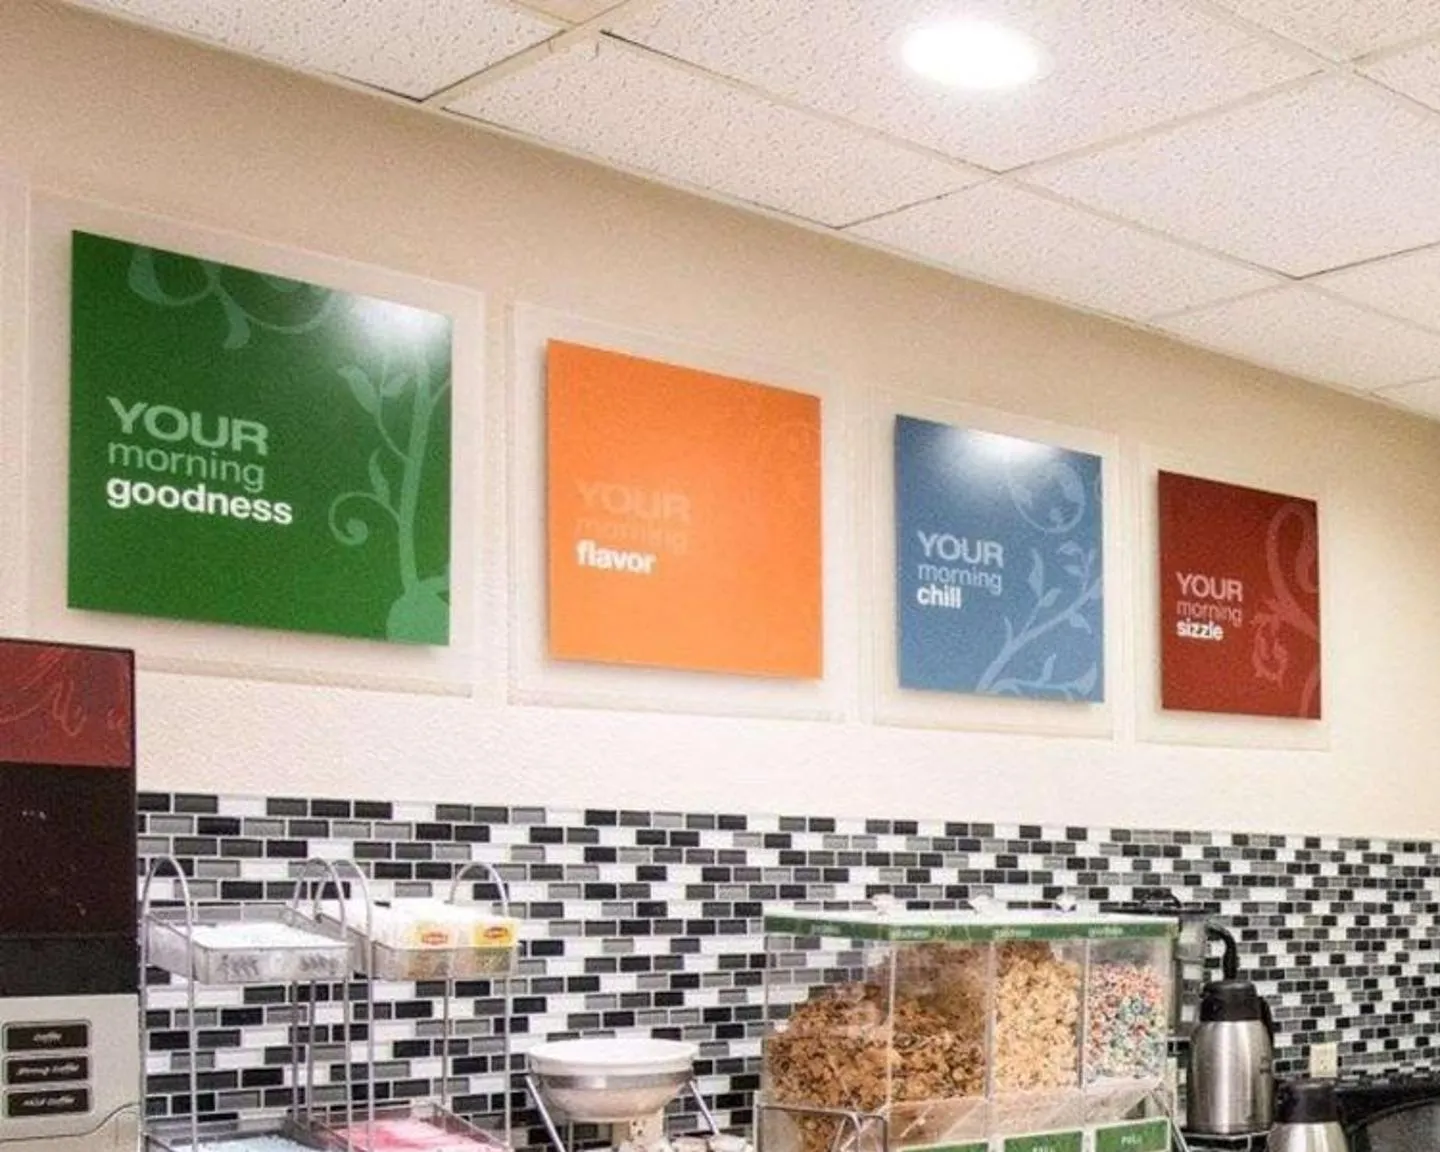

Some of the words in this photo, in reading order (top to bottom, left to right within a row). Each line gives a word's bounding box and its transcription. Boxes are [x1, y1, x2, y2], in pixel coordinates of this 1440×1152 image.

[106, 396, 269, 456] YOUR
[108, 441, 265, 493] morning
[106, 477, 293, 524] goodness
[576, 480, 692, 523] YOUR
[576, 539, 657, 574] flavor
[917, 530, 1004, 568] YOUR
[917, 583, 961, 609] chill
[918, 563, 1002, 596] morning
[1176, 571, 1243, 602] YOUR
[1177, 600, 1242, 628] morning
[1177, 618, 1224, 641] sizzle
